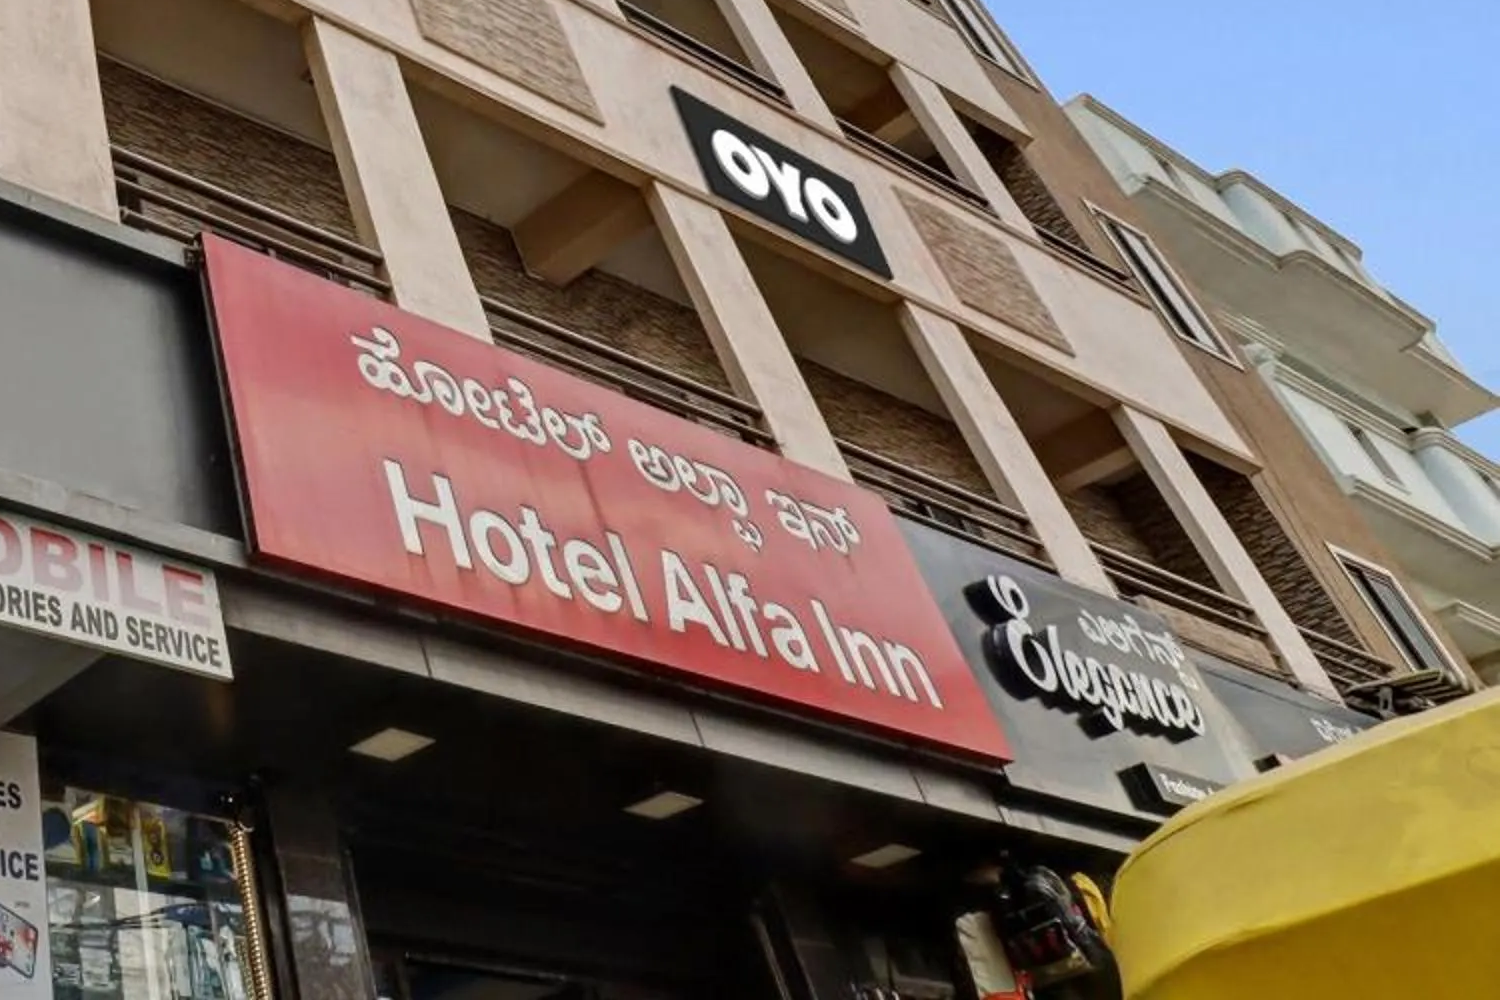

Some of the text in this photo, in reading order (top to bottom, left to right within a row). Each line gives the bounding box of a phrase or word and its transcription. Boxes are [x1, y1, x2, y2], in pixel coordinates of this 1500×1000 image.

[711, 128, 858, 245] OYO
[765, 488, 862, 555] ಇನ್
[70, 602, 119, 641] AND
[126, 615, 223, 669] SERVICE
[383, 459, 945, 711] Hotel Alfa Inn
[987, 574, 1206, 737] Elegance
